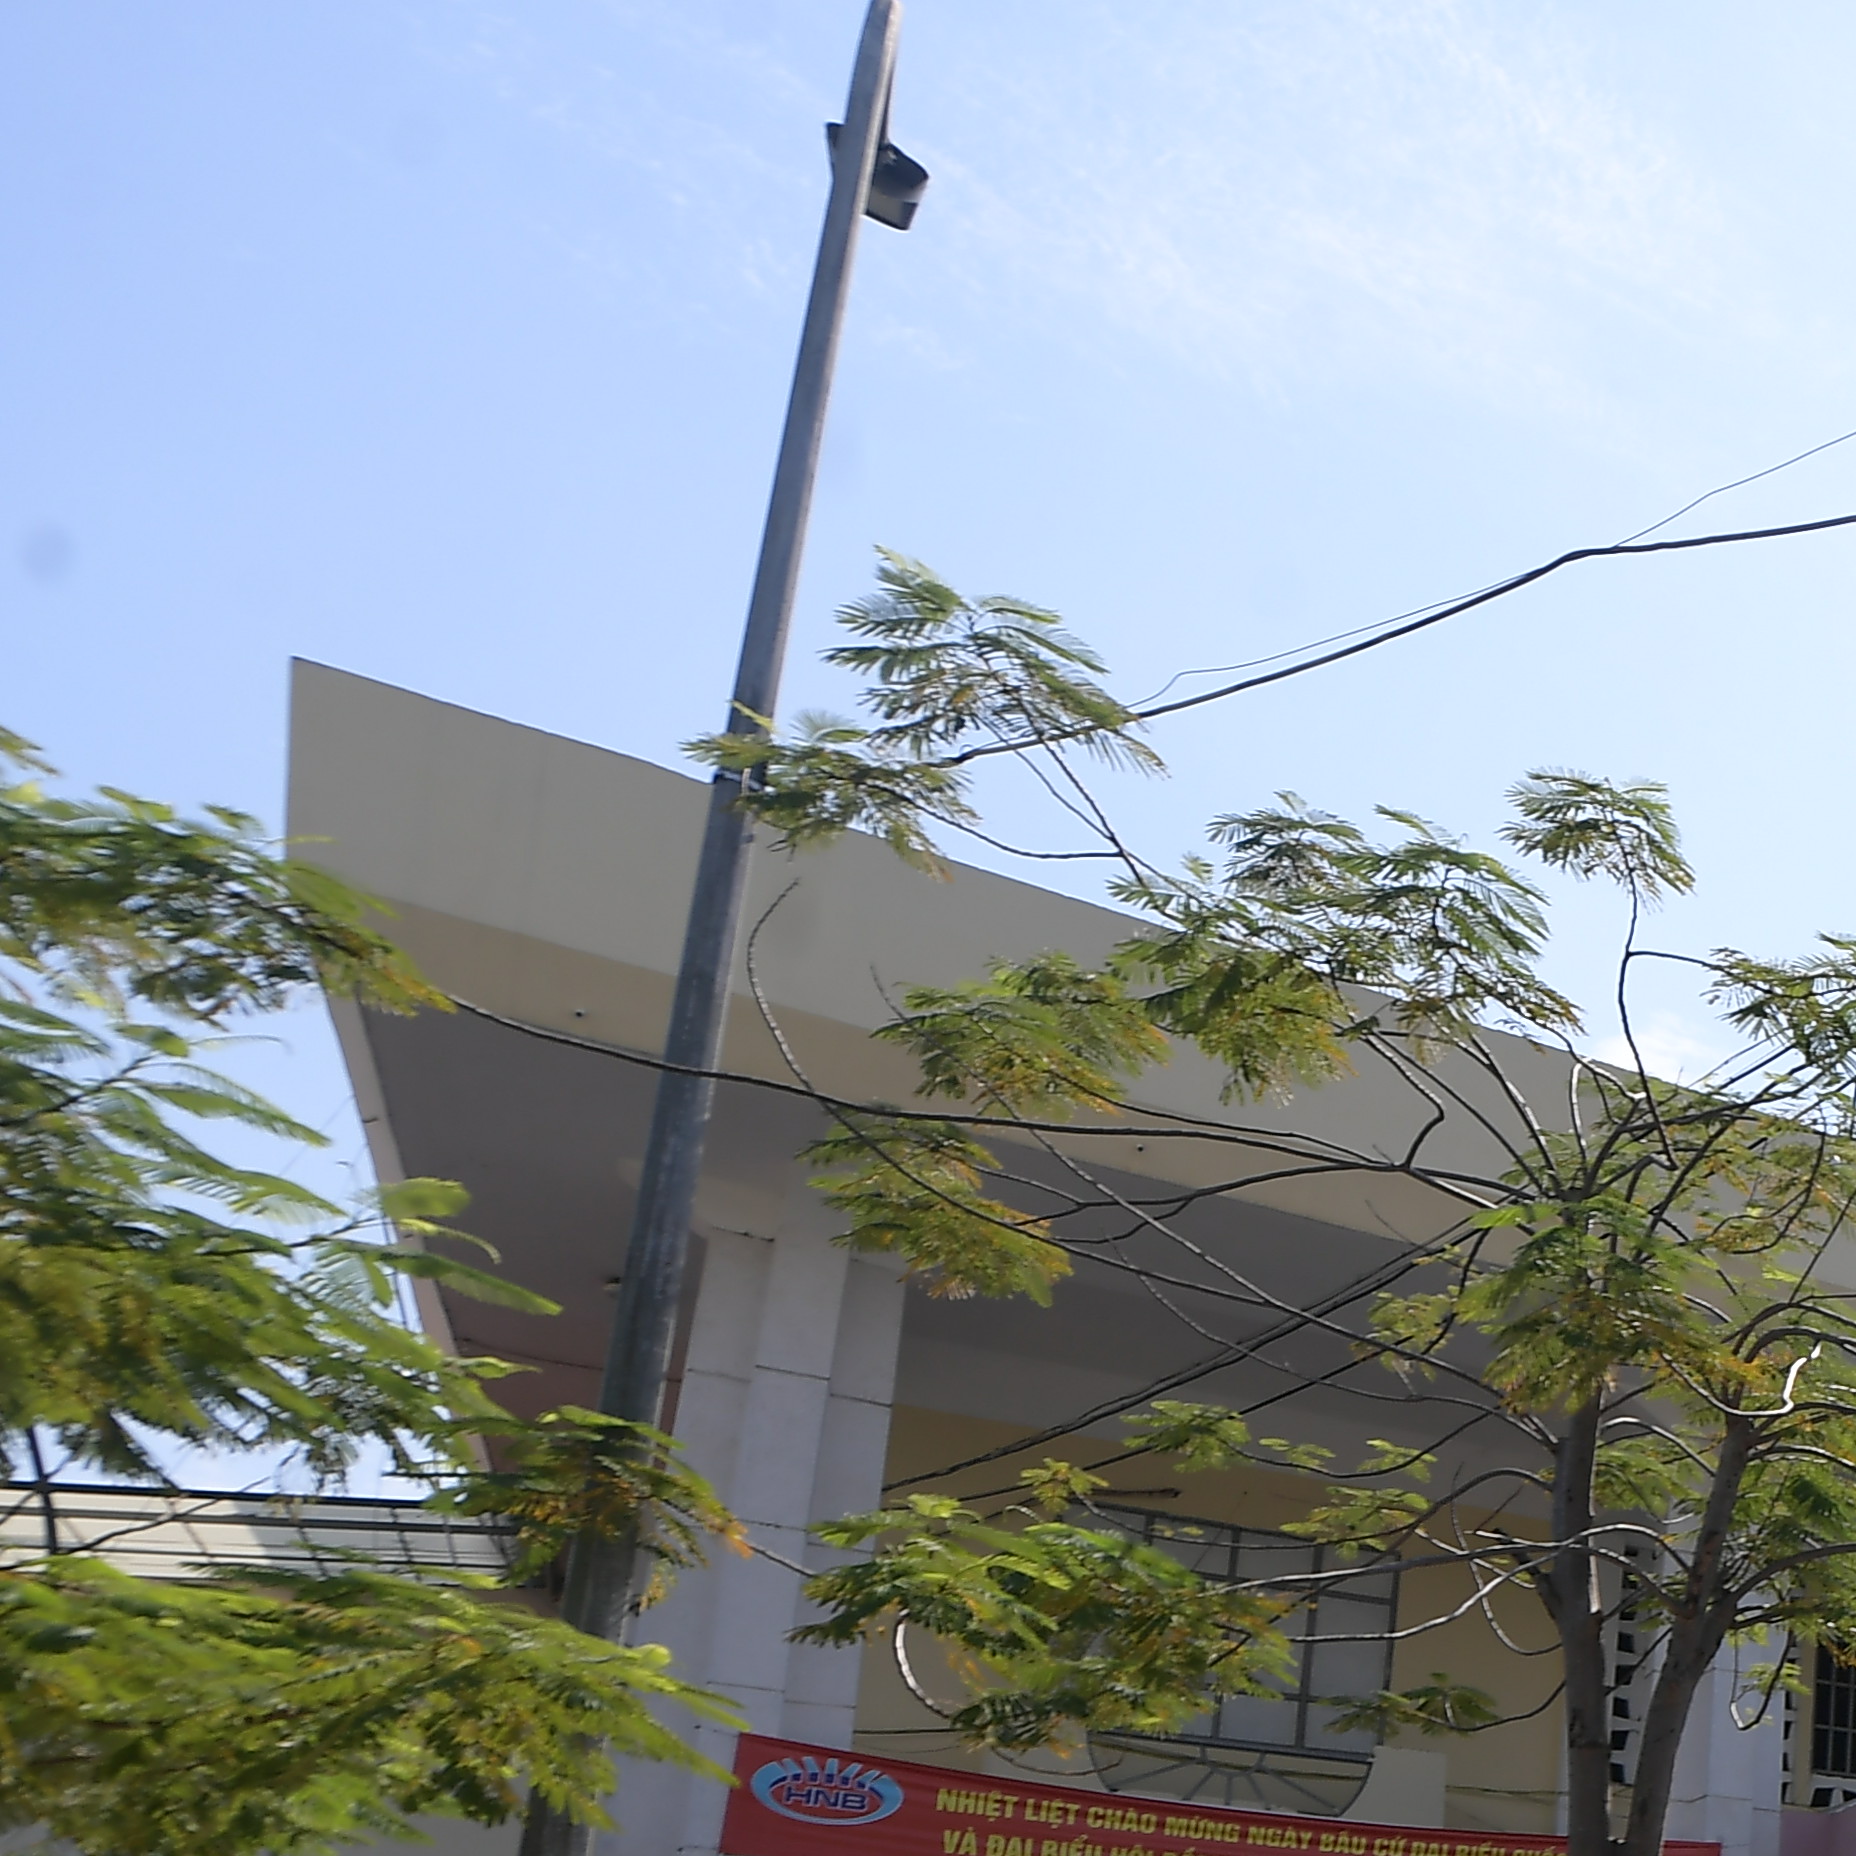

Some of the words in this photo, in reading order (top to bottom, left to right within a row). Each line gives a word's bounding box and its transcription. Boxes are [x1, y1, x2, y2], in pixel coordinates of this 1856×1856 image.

[783, 1782, 868, 1812] HNB
[936, 1788, 1019, 1822] NHIỆT
[1025, 1798, 1081, 1829] LIỆT
[1087, 1805, 1157, 1835] CHÀO
[943, 1826, 978, 1856] VÀ
